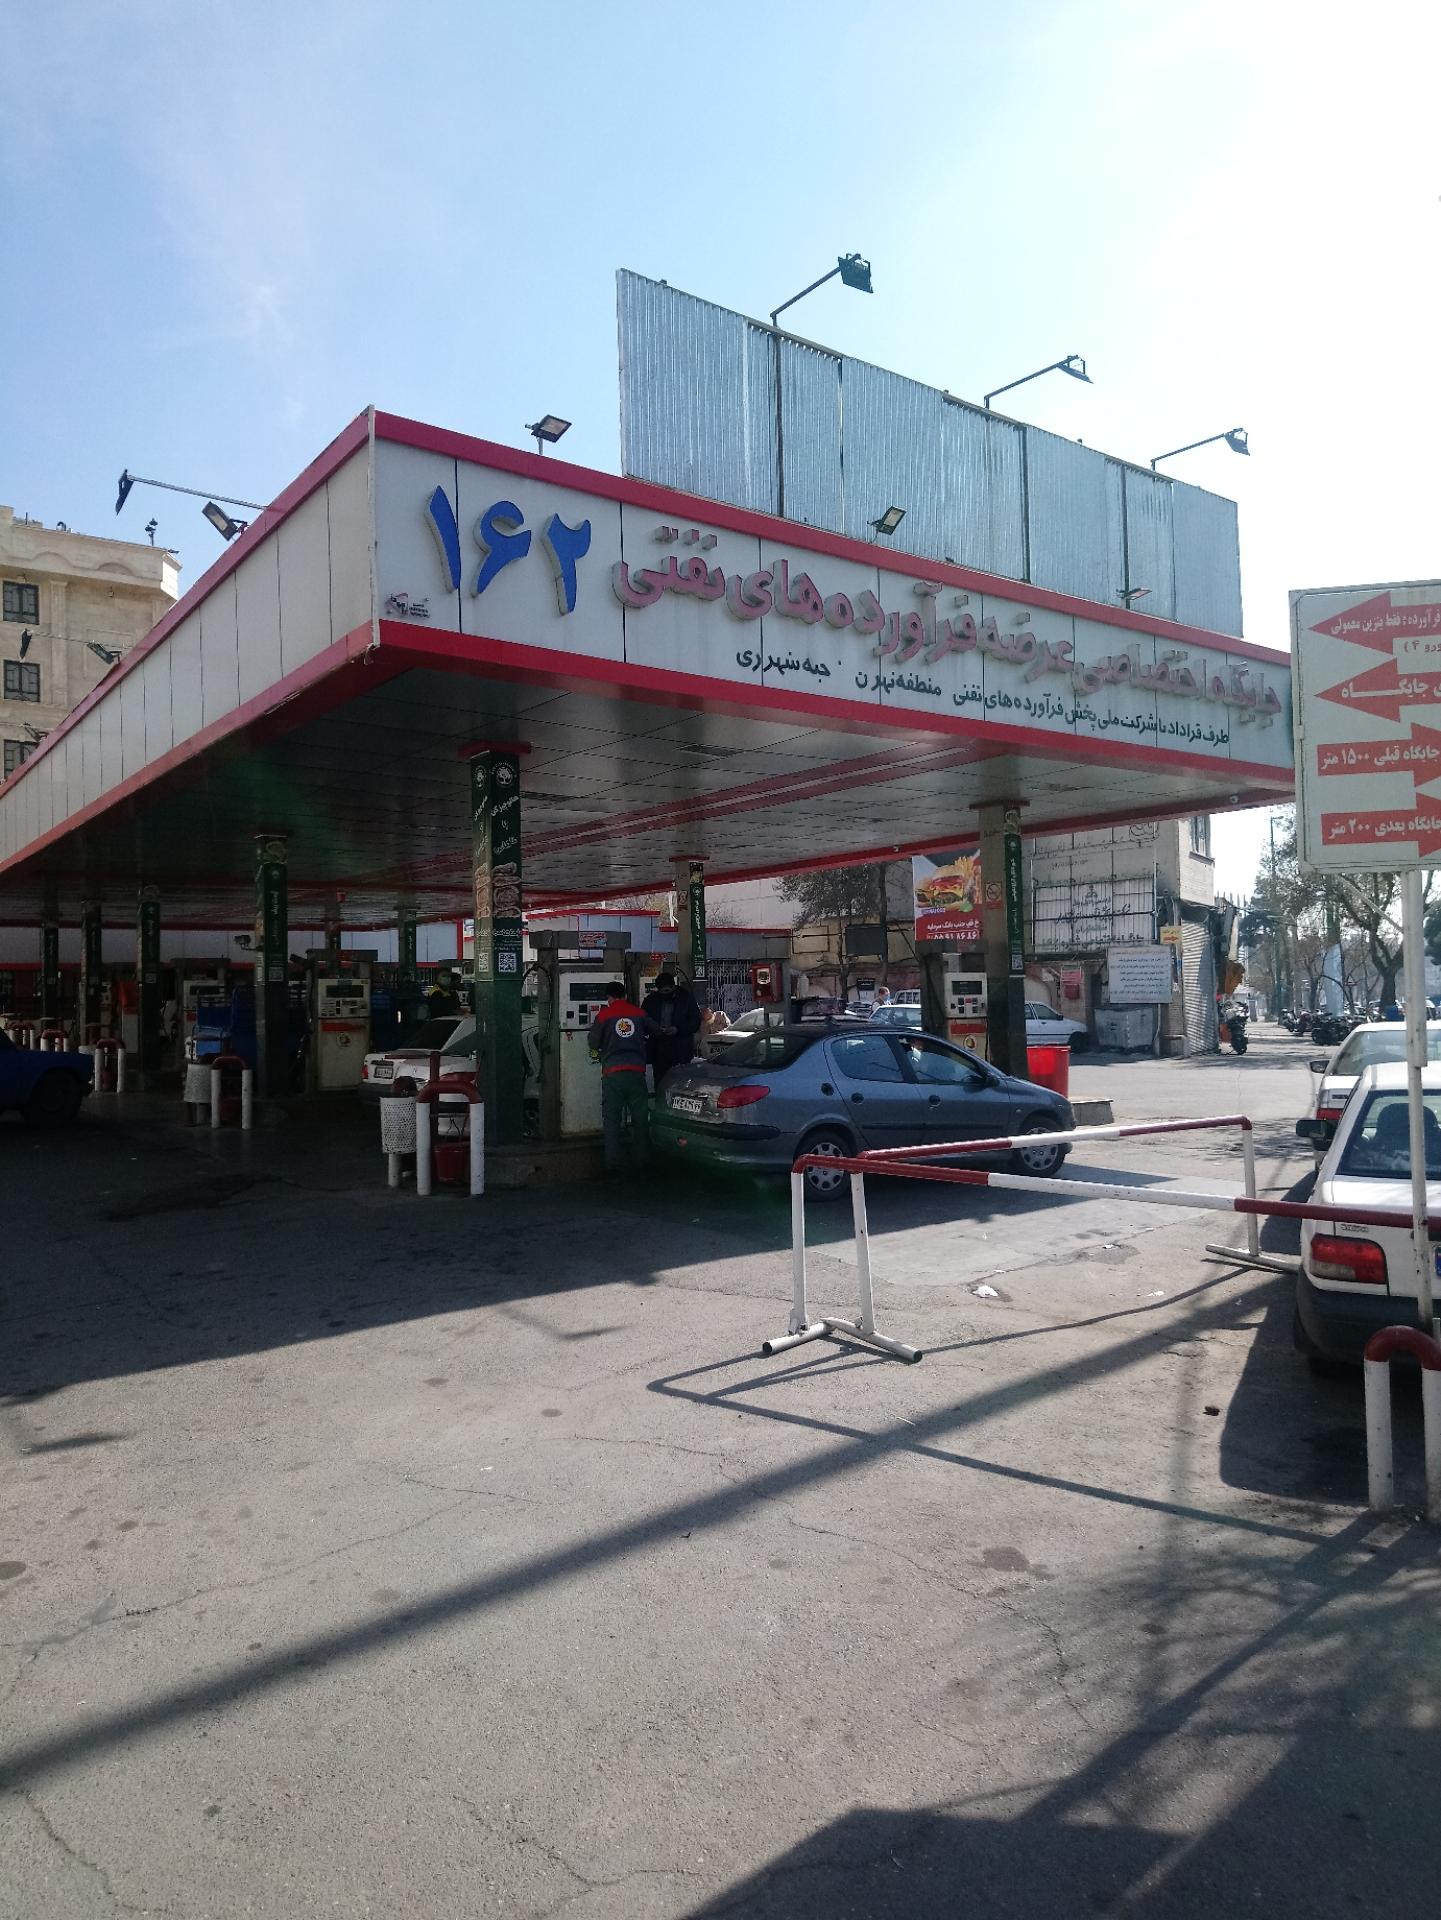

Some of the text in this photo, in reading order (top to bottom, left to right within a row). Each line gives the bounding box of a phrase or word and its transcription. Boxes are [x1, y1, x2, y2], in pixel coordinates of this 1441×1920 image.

[424, 485, 591, 615] ۱۶۲
[612, 526, 726, 608] نفتی
[1331, 618, 1361, 634] معمولی
[1362, 616, 1384, 632] بنزین
[1385, 611, 1401, 626] فقط
[977, 612, 1075, 683] عرضه
[1065, 701, 1097, 731] پخش
[1098, 709, 1120, 730] ملی
[1121, 713, 1158, 734] شرکت
[1203, 725, 1230, 747] طرف
[1320, 744, 1440, 770] جایگاه قبلی ۱۵۰۰ متر
[1328, 822, 1346, 839] متر
[1348, 818, 1370, 834] ۲۰۰
[1374, 820, 1405, 837] بعدی
